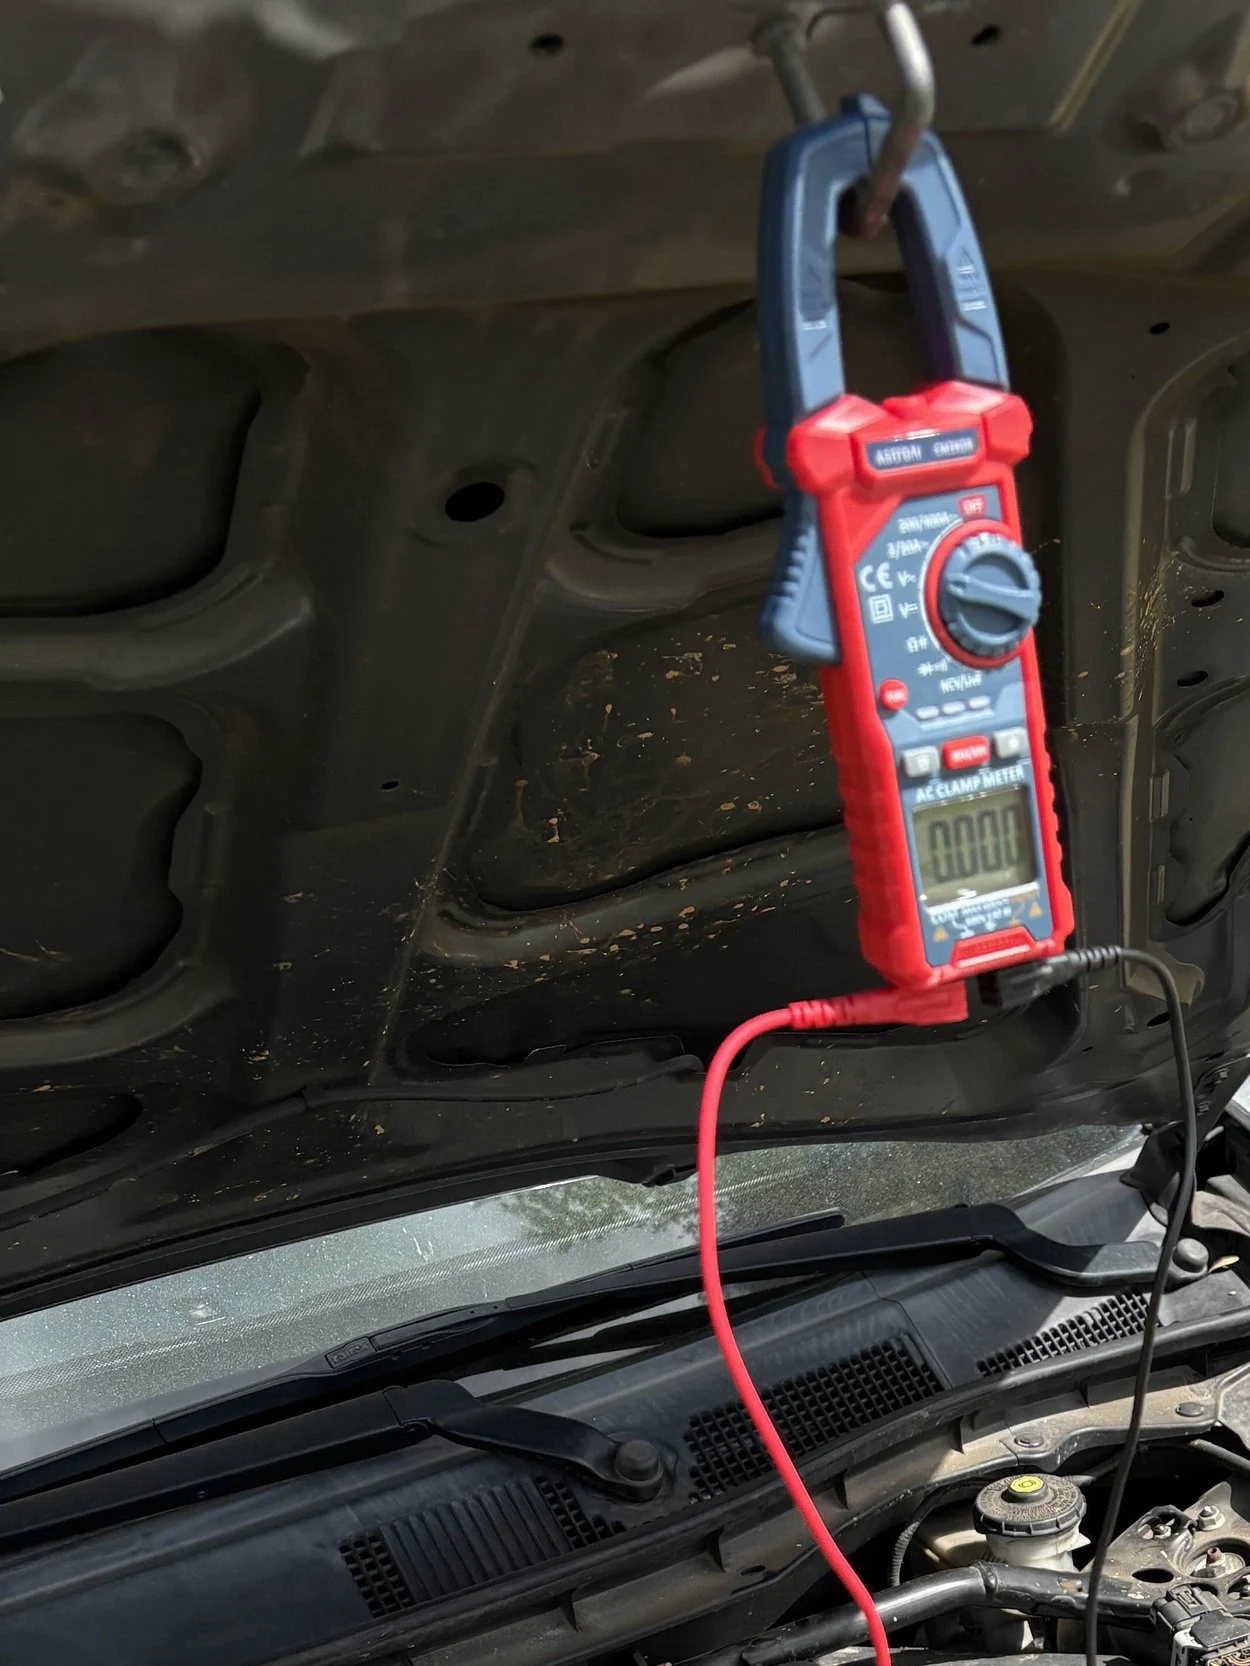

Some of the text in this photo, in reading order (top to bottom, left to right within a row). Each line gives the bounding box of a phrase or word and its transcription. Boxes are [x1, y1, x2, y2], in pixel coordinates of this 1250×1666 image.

[915, 763, 1025, 804] AC CLAMP METER
